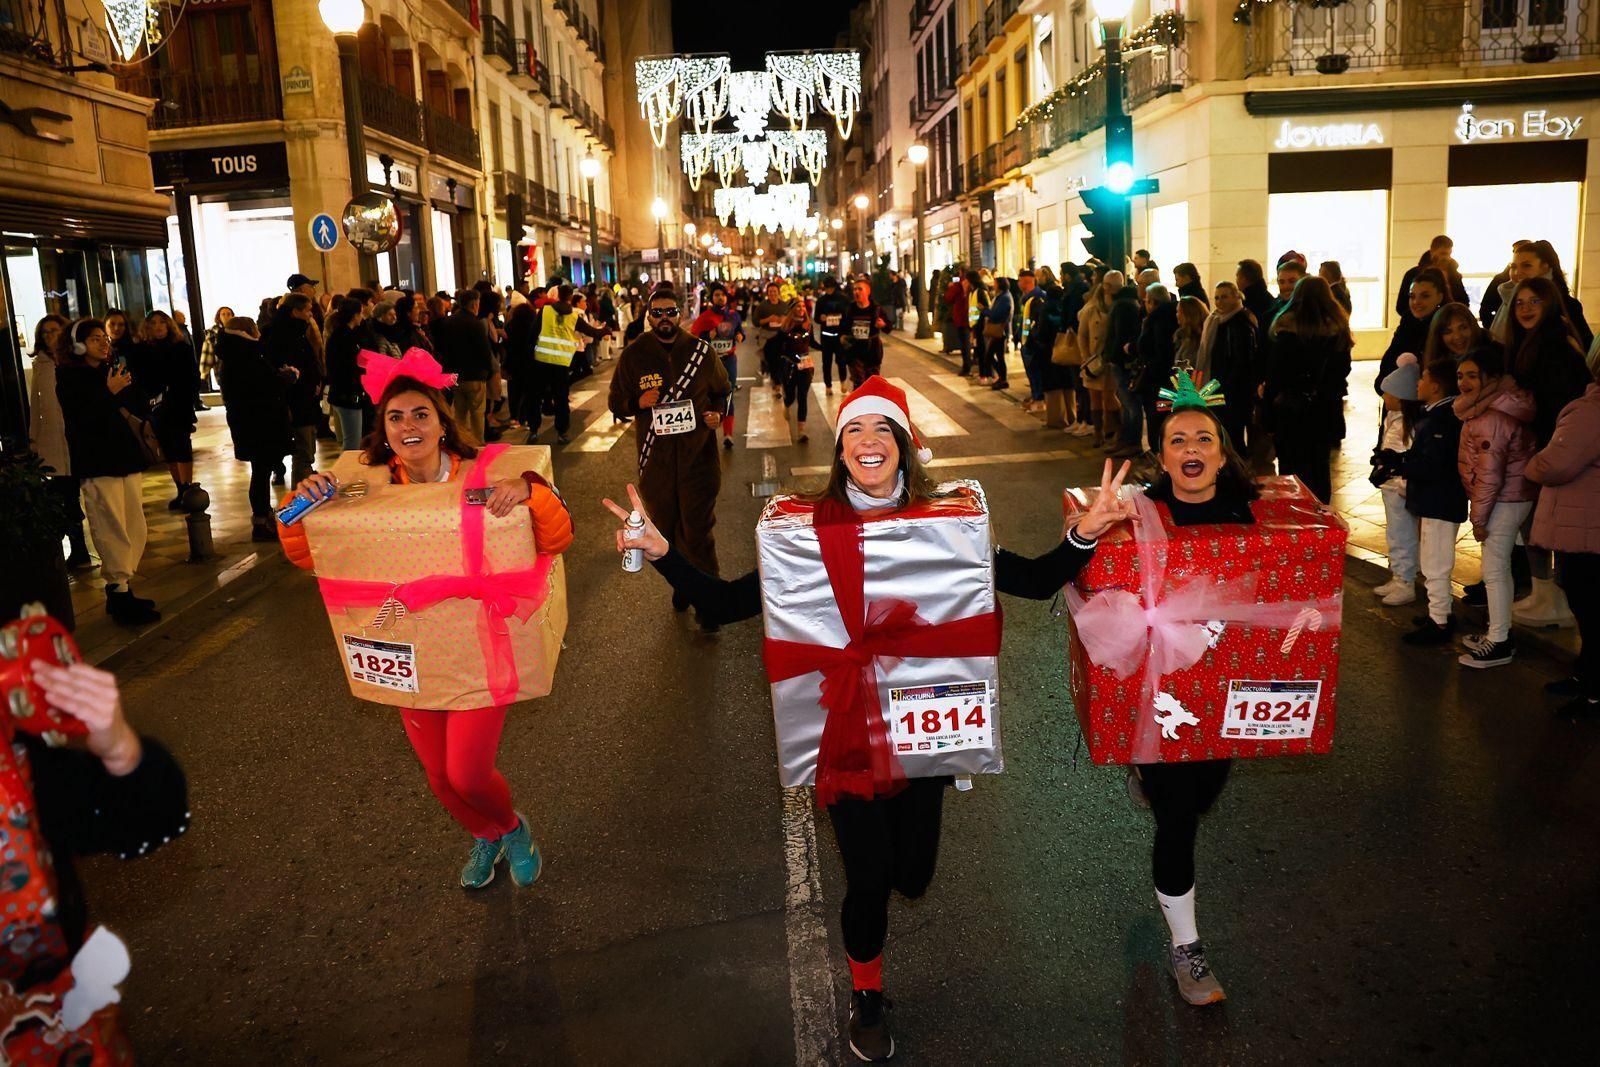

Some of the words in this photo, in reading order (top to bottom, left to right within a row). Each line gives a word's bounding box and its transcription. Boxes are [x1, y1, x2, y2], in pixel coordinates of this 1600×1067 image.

[1455, 104, 1517, 144] San
[211, 154, 257, 175] TOUS
[639, 380, 663, 390] WARS
[640, 373, 663, 382] STAR
[656, 410, 693, 426] 1244
[352, 652, 413, 678] 1825
[1231, 681, 1242, 692] 31
[1241, 685, 1272, 693] NOCTURNA
[891, 688, 902, 703] 31
[903, 692, 935, 701] NOCTURNA
[1233, 700, 1312, 722] 1824
[900, 705, 986, 735] 1814
